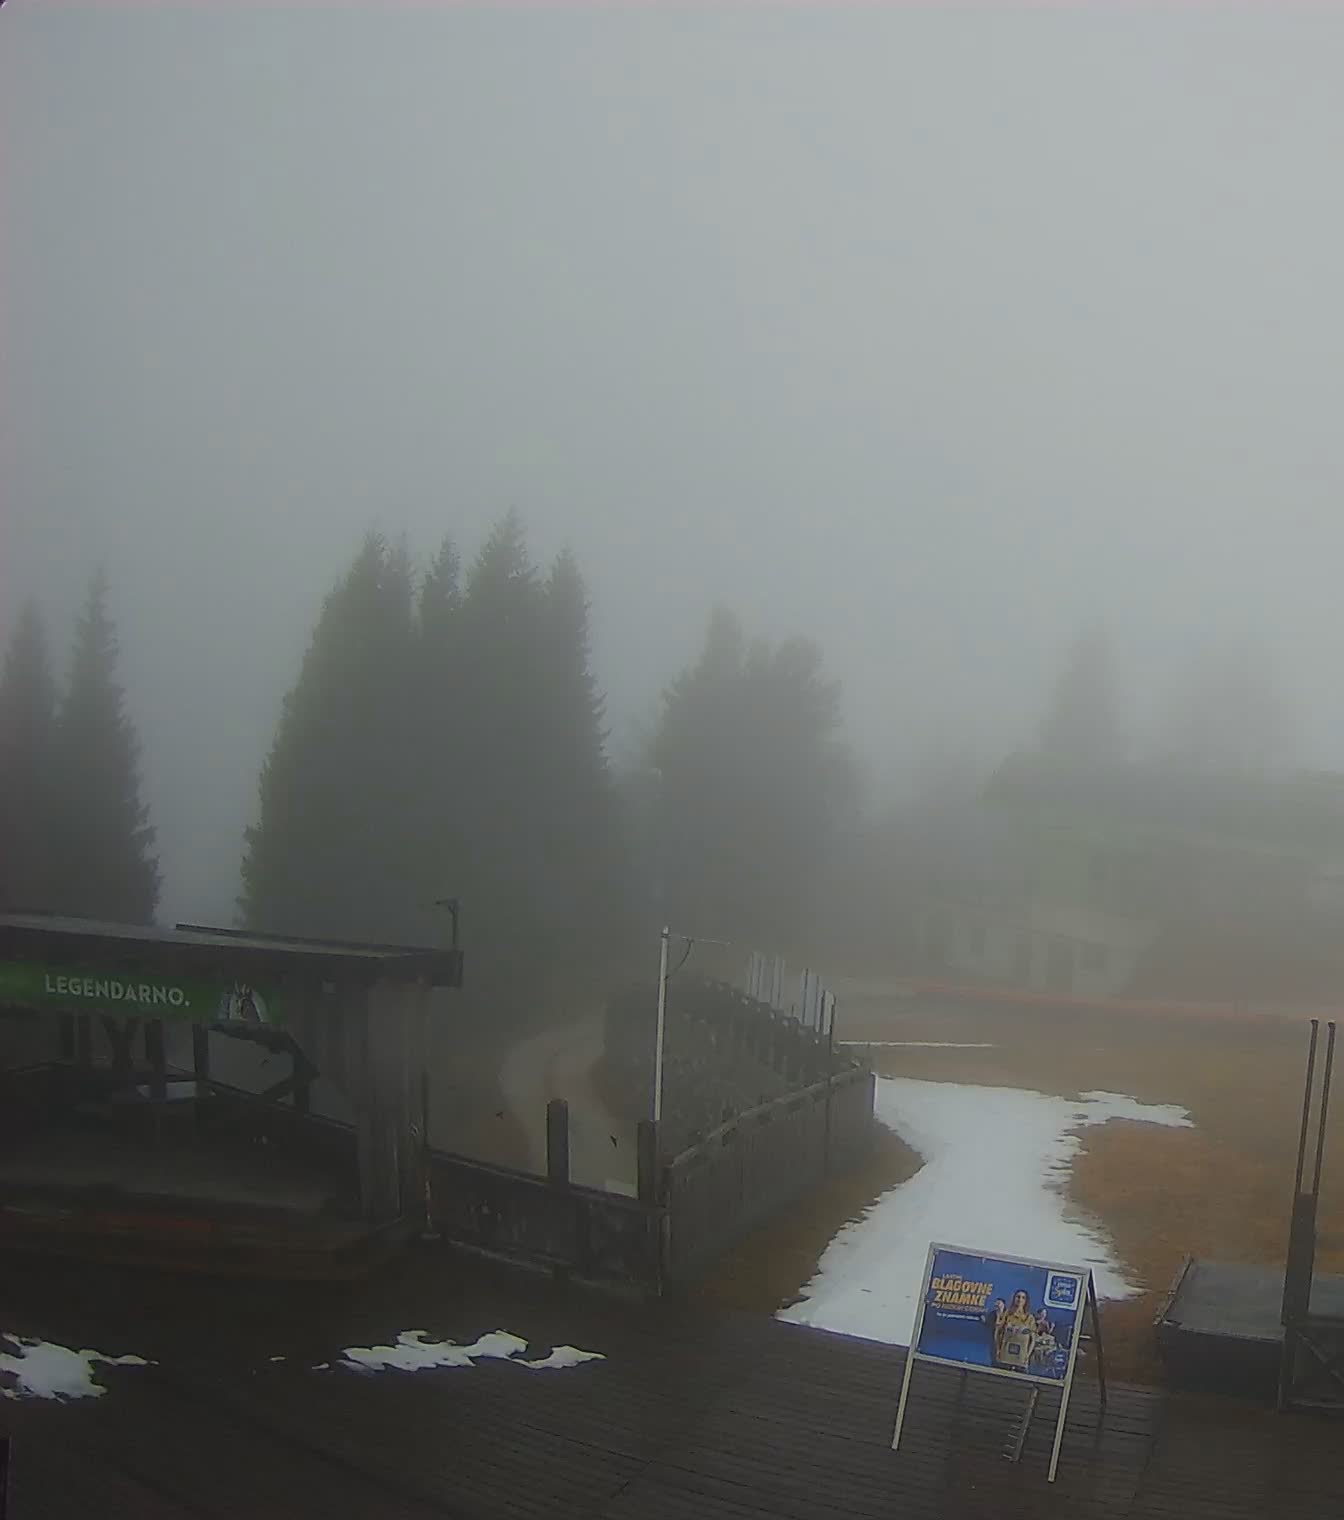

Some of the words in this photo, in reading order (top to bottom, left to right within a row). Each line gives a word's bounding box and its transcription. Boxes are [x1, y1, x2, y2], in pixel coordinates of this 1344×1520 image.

[44, 974, 191, 1007] LEGENDARNO.
[931, 1277, 993, 1296] BLAGOVNE
[934, 1290, 987, 1307] ZNAMKE
